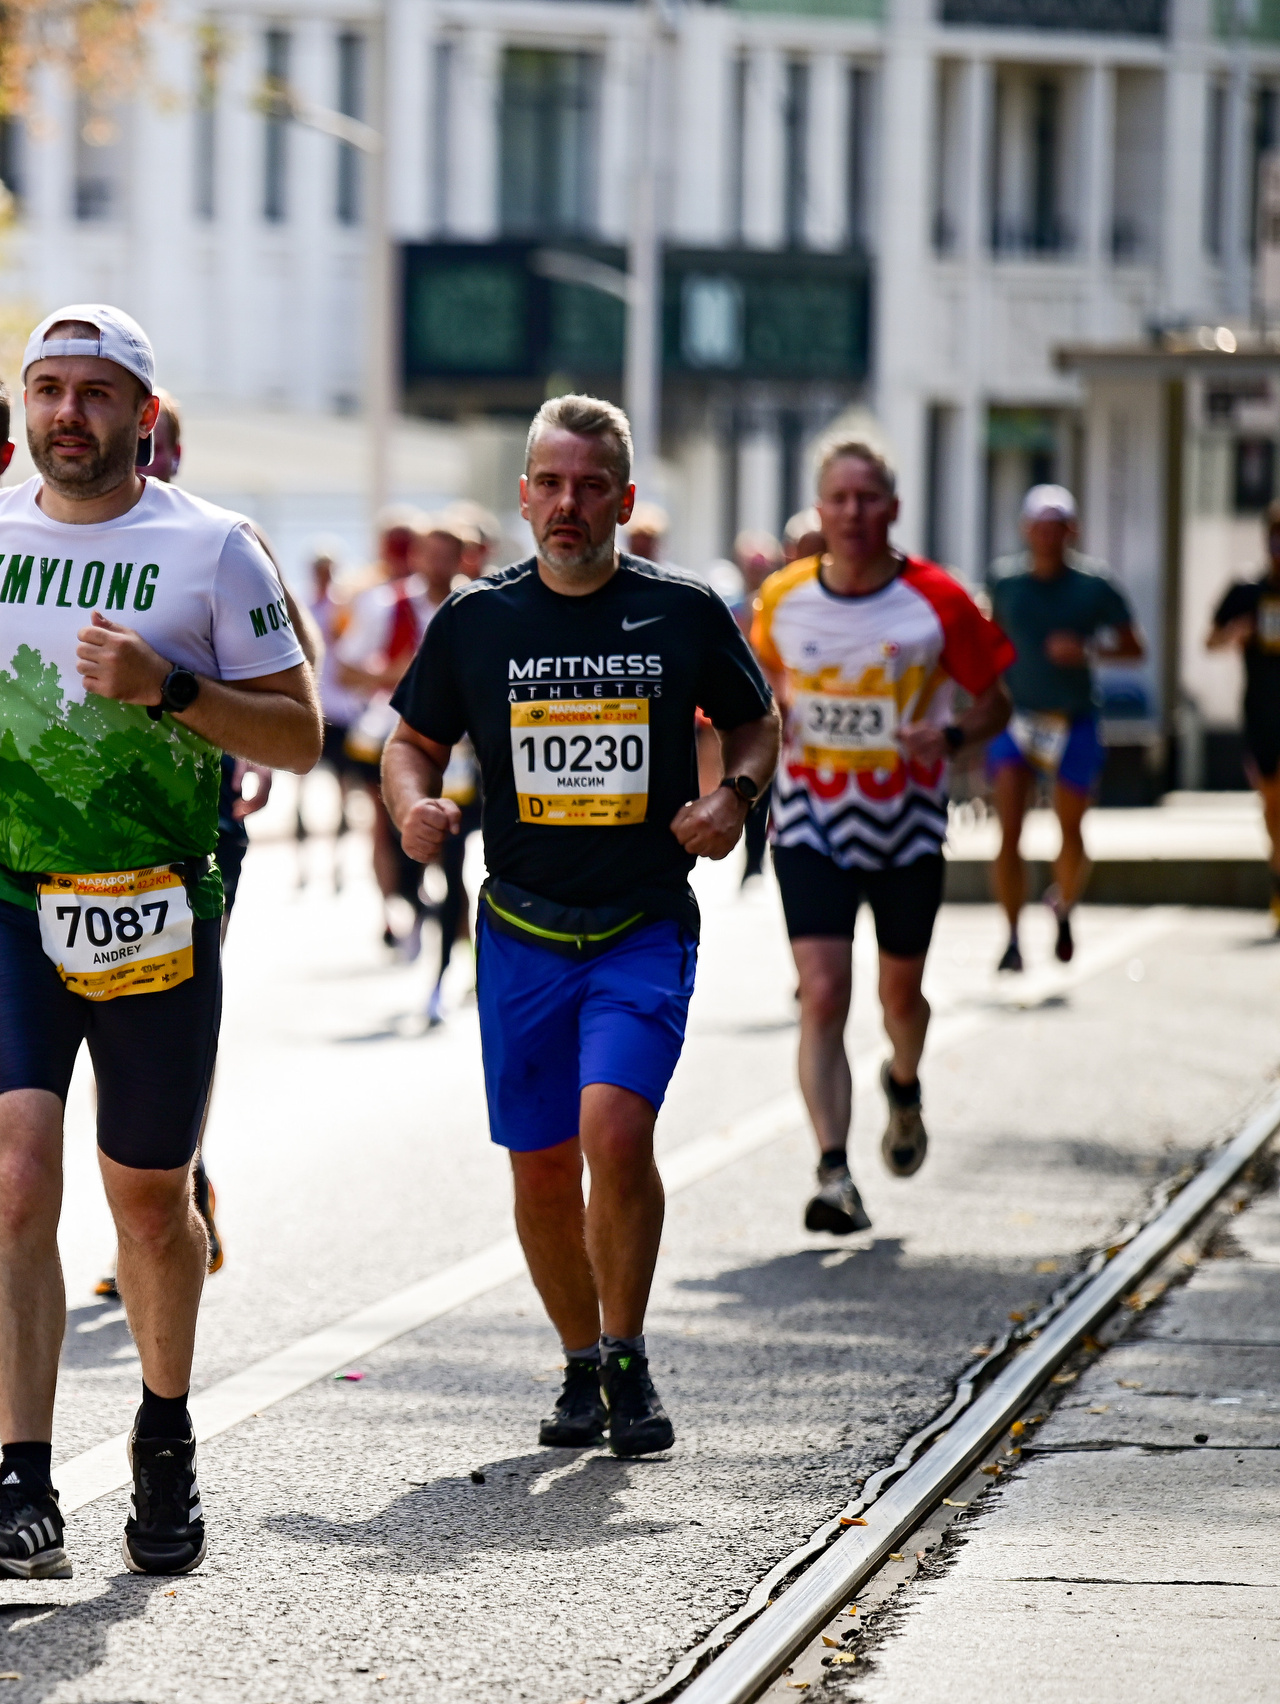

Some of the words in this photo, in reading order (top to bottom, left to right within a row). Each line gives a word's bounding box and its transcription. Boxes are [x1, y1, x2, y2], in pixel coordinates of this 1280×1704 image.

[507, 654, 663, 680] MFITNESS
[507, 683, 663, 701] ATHLETES
[808, 701, 884, 736] 3223
[519, 735, 644, 773] 10230
[556, 777, 605, 788] МАКСИМ
[528, 797, 544, 818] D
[77, 873, 135, 887] МАРАФОН
[77, 884, 126, 894] МОСКВА
[56, 900, 169, 948] 7087
[93, 944, 142, 964] ANDREY
